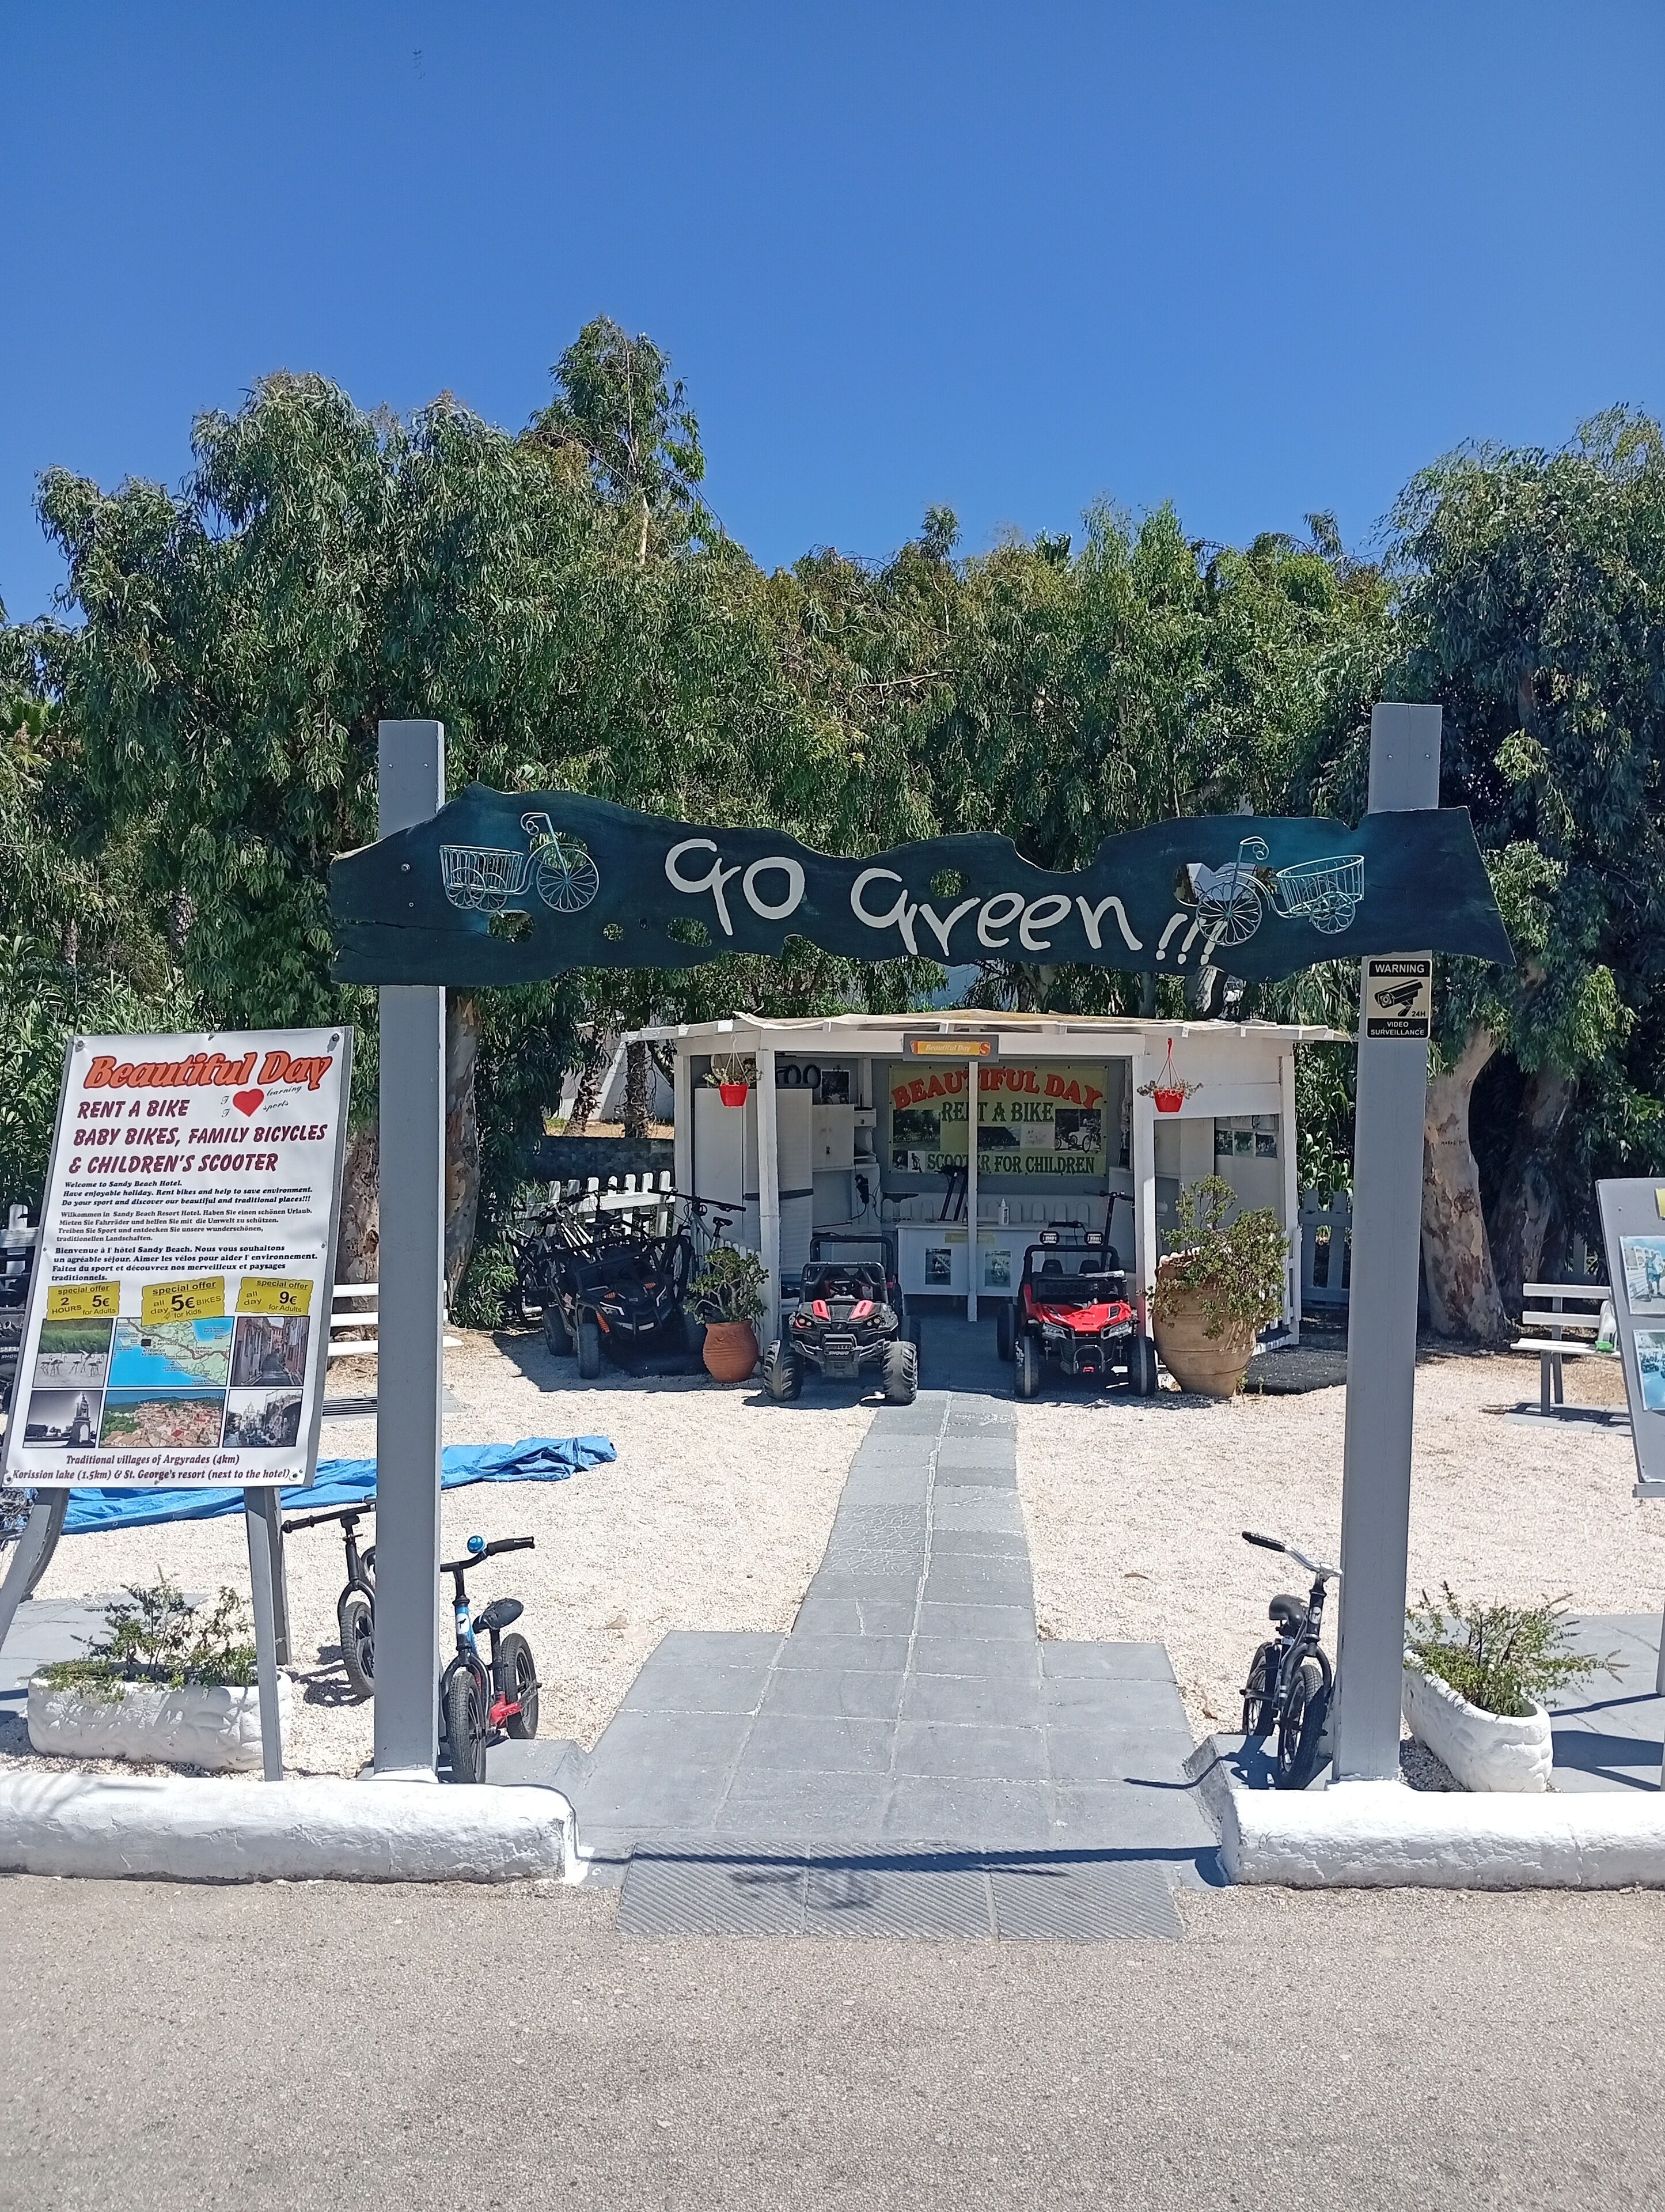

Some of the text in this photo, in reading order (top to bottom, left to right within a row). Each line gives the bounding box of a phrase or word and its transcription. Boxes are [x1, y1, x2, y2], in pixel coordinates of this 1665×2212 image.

[1375, 964, 1424, 973] WARNING
[83, 1050, 333, 1091] Beautiful Day
[267, 1086, 302, 1097] learning
[1044, 1074, 1103, 1109] DAY
[77, 1099, 190, 1120] RENT A BIKE
[263, 1100, 289, 1112] sports
[992, 1102, 1007, 1122] A
[1011, 1102, 1054, 1122] BIKE
[73, 1124, 328, 1147] BABY BIKES, FAMILY BICYCLES
[68, 1153, 279, 1175] & CHILDREN'S SCOOTER
[927, 1153, 1094, 1175] SCOOR FOR CHILDREN
[109, 1181, 132, 1189] Sandy
[58, 1286, 87, 1295] special
[153, 1282, 216, 1296] special offer
[60, 1297, 69, 1306] 2
[92, 1295, 110, 1307] 5€
[171, 1294, 221, 1312] 5€ BIKES
[279, 1291, 297, 1305] 9€
[52, 1305, 82, 1314] HOURS
[66, 1455, 240, 1466] Traditional villages of Argyrades (4km)
[13, 1468, 290, 1480] Korission lake (1.5km) & St. George's resort (next to the hotel)
